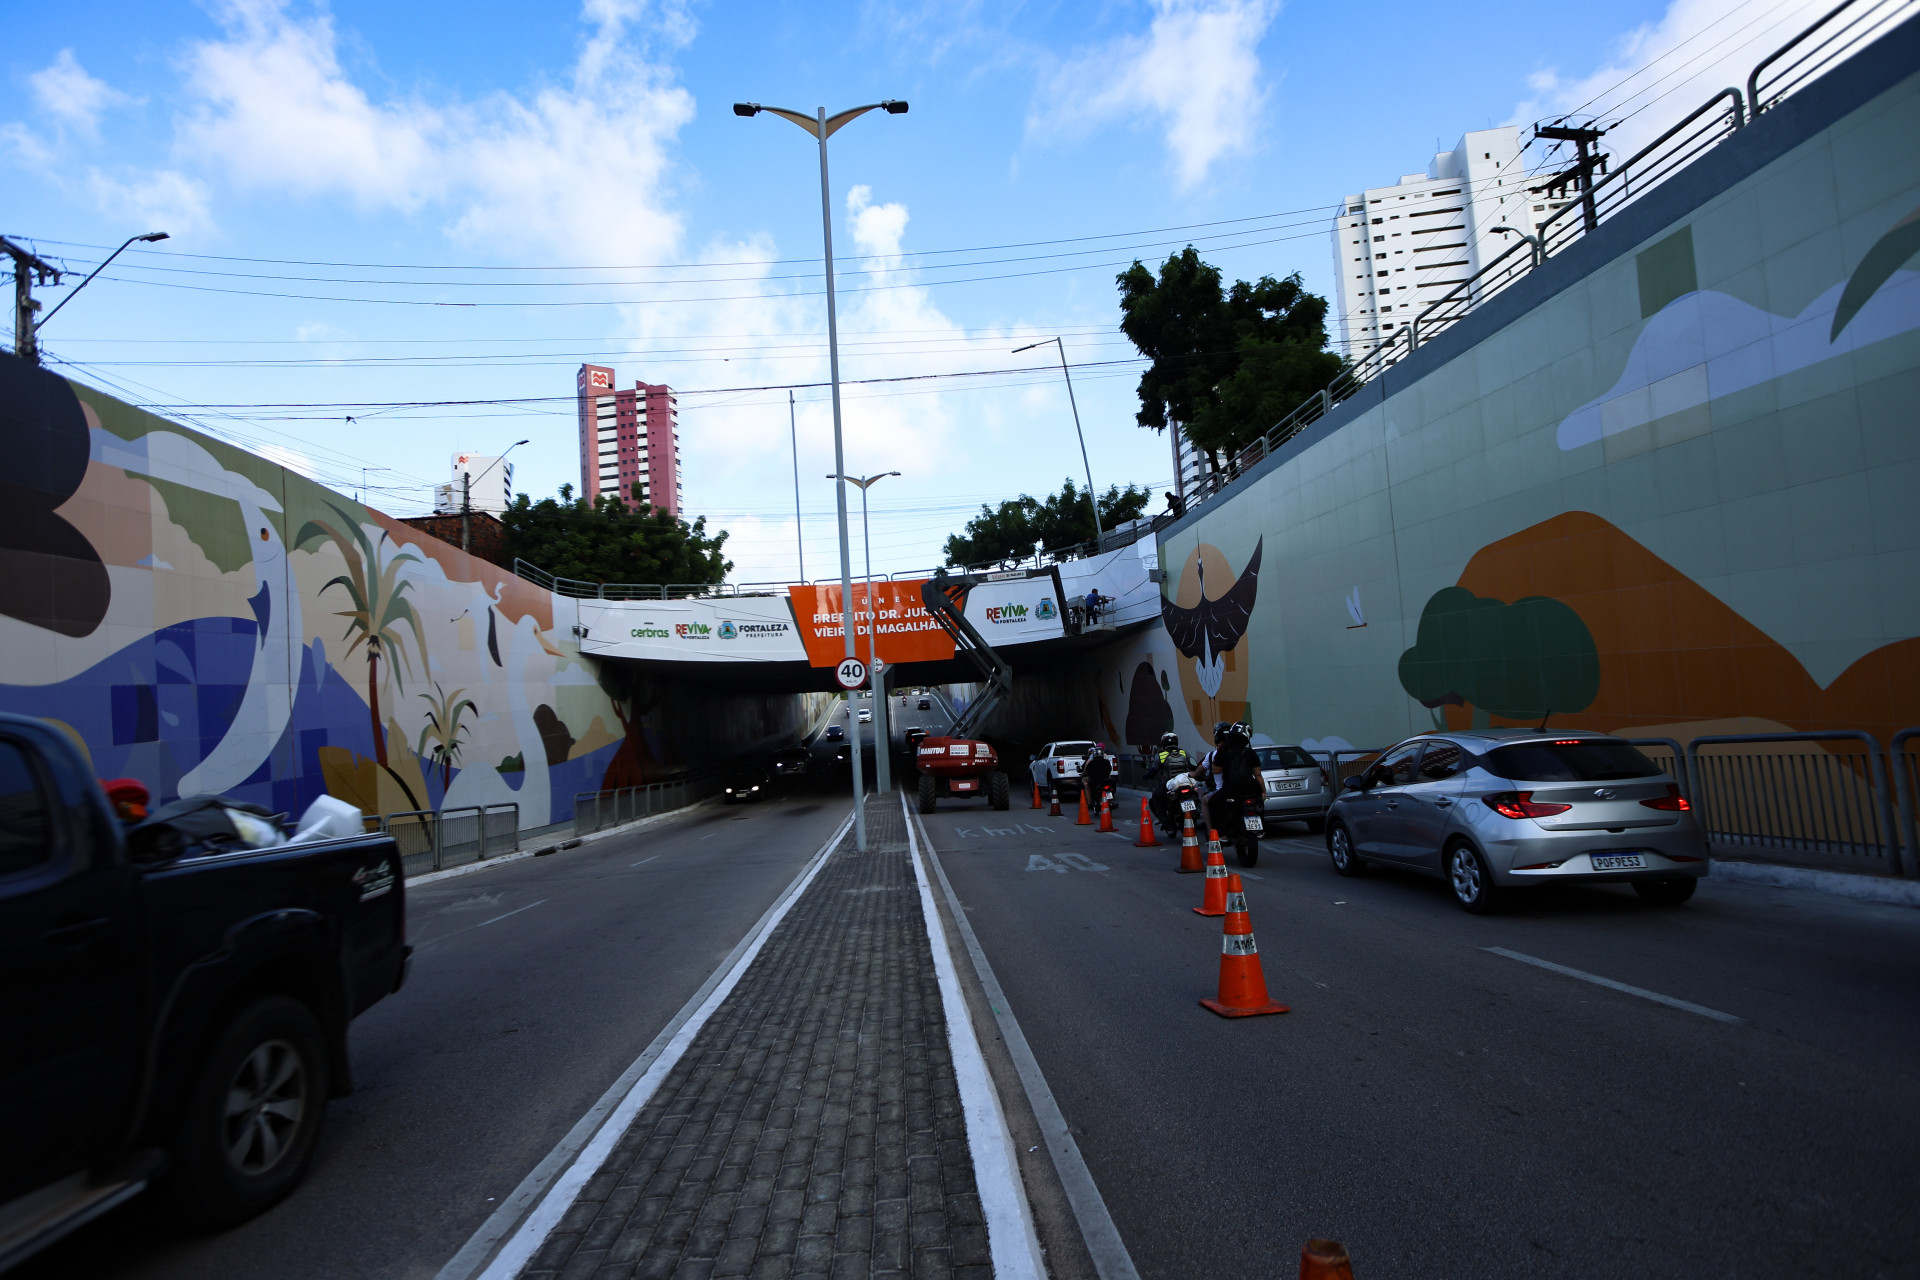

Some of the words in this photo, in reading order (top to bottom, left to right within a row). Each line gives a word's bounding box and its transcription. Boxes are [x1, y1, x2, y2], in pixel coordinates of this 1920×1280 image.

[813, 611, 875, 623] PREFITO
[879, 609, 901, 620] DR.
[986, 602, 1028, 621] REVIVA
[631, 627, 669, 638] cerbras
[675, 621, 711, 636] REVIVA
[739, 624, 788, 632] FORTALEZA
[814, 626, 855, 637] VIEIR
[841, 665, 862, 677] 40
[1025, 852, 1111, 874] 40
[1233, 938, 1255, 950] AMC
